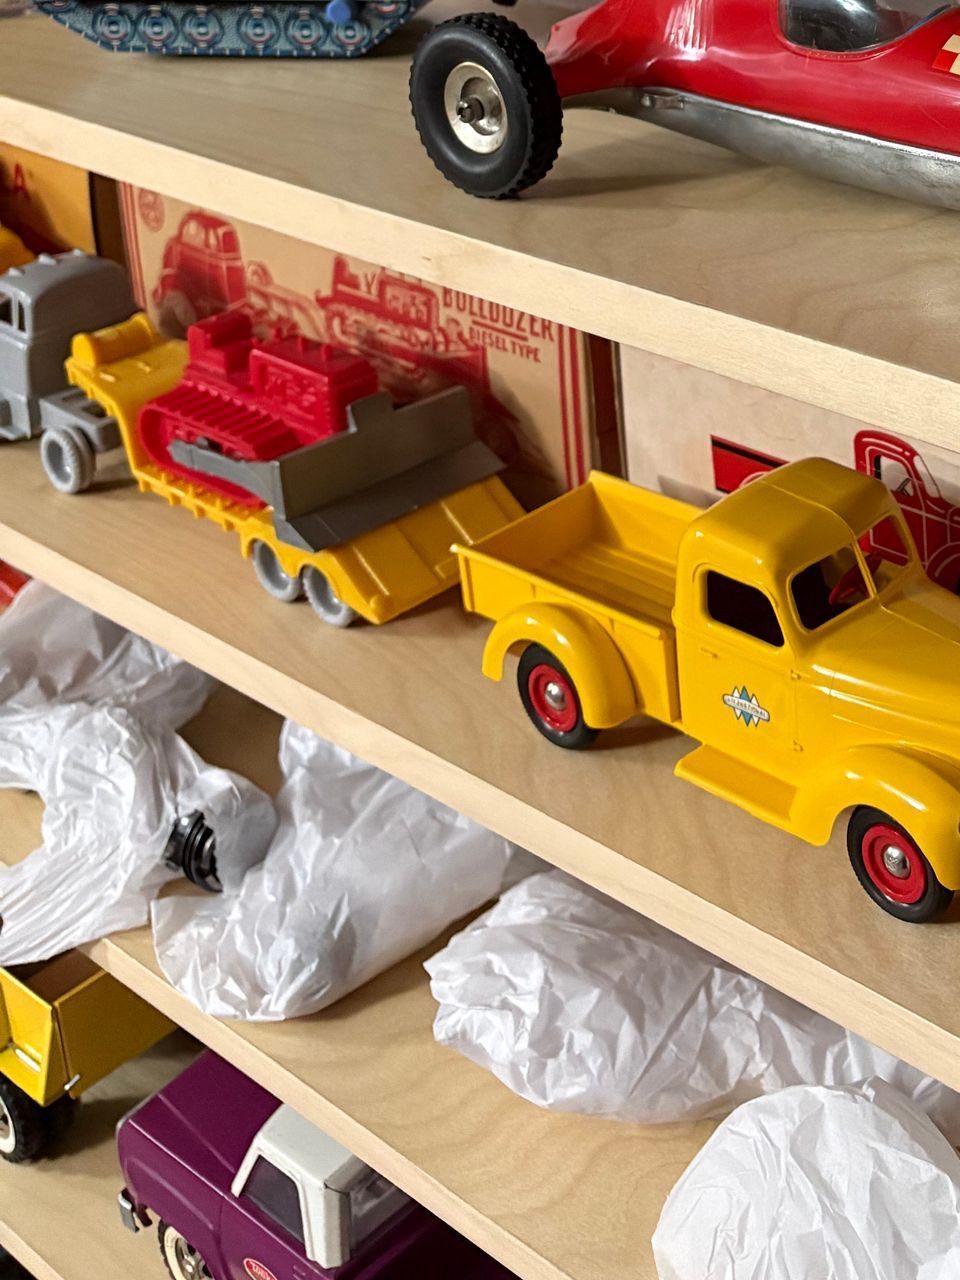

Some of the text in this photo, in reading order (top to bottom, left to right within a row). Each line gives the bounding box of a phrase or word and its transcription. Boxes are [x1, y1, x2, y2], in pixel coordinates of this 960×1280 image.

[443, 285, 555, 343] BULLDOZER
[469, 325, 542, 364] DIESEL TYPE
